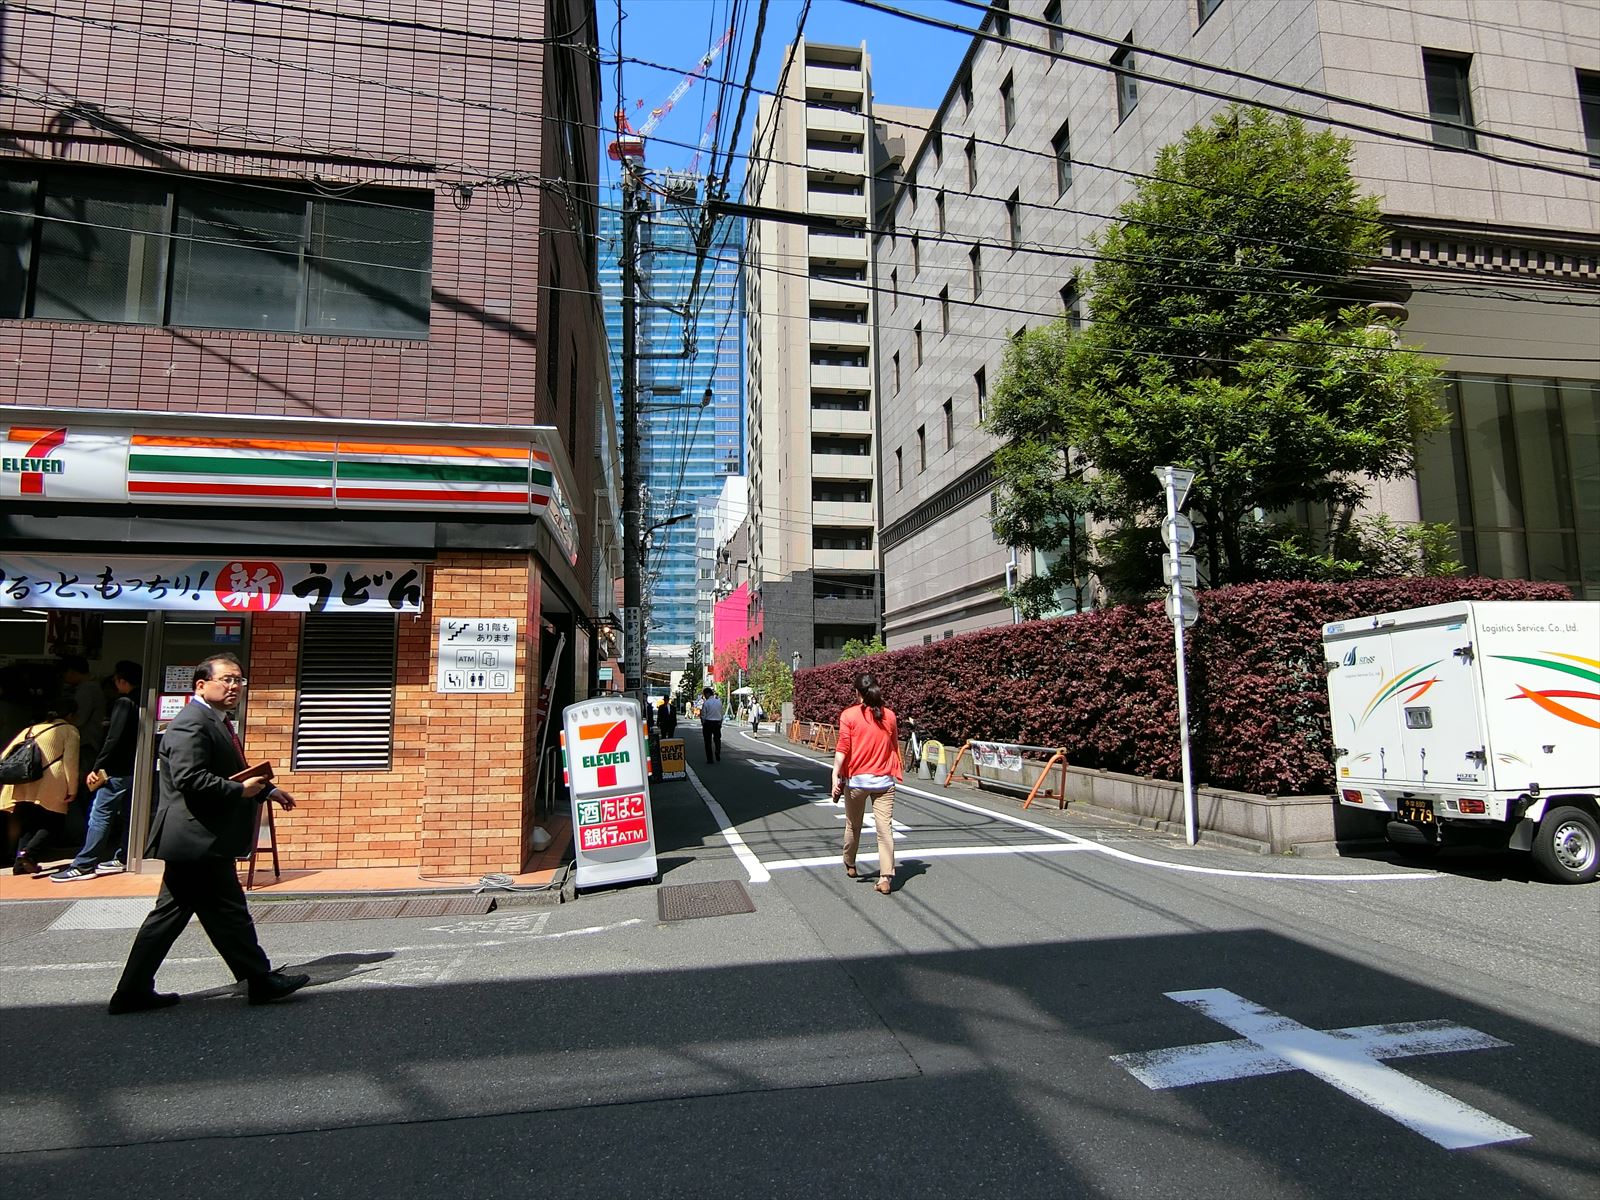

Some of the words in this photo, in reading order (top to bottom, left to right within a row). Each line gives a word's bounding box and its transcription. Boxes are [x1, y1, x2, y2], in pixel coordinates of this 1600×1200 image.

[0, 566, 210, 600] るっと、もっちり!
[477, 622, 510, 632] B1階も
[1481, 623, 1515, 635] Logistics
[476, 634, 510, 642] あります
[660, 744, 685, 754] CRAFT
[661, 752, 684, 762] BEER
[579, 801, 600, 825] 酒
[602, 797, 644, 821] たばこ
